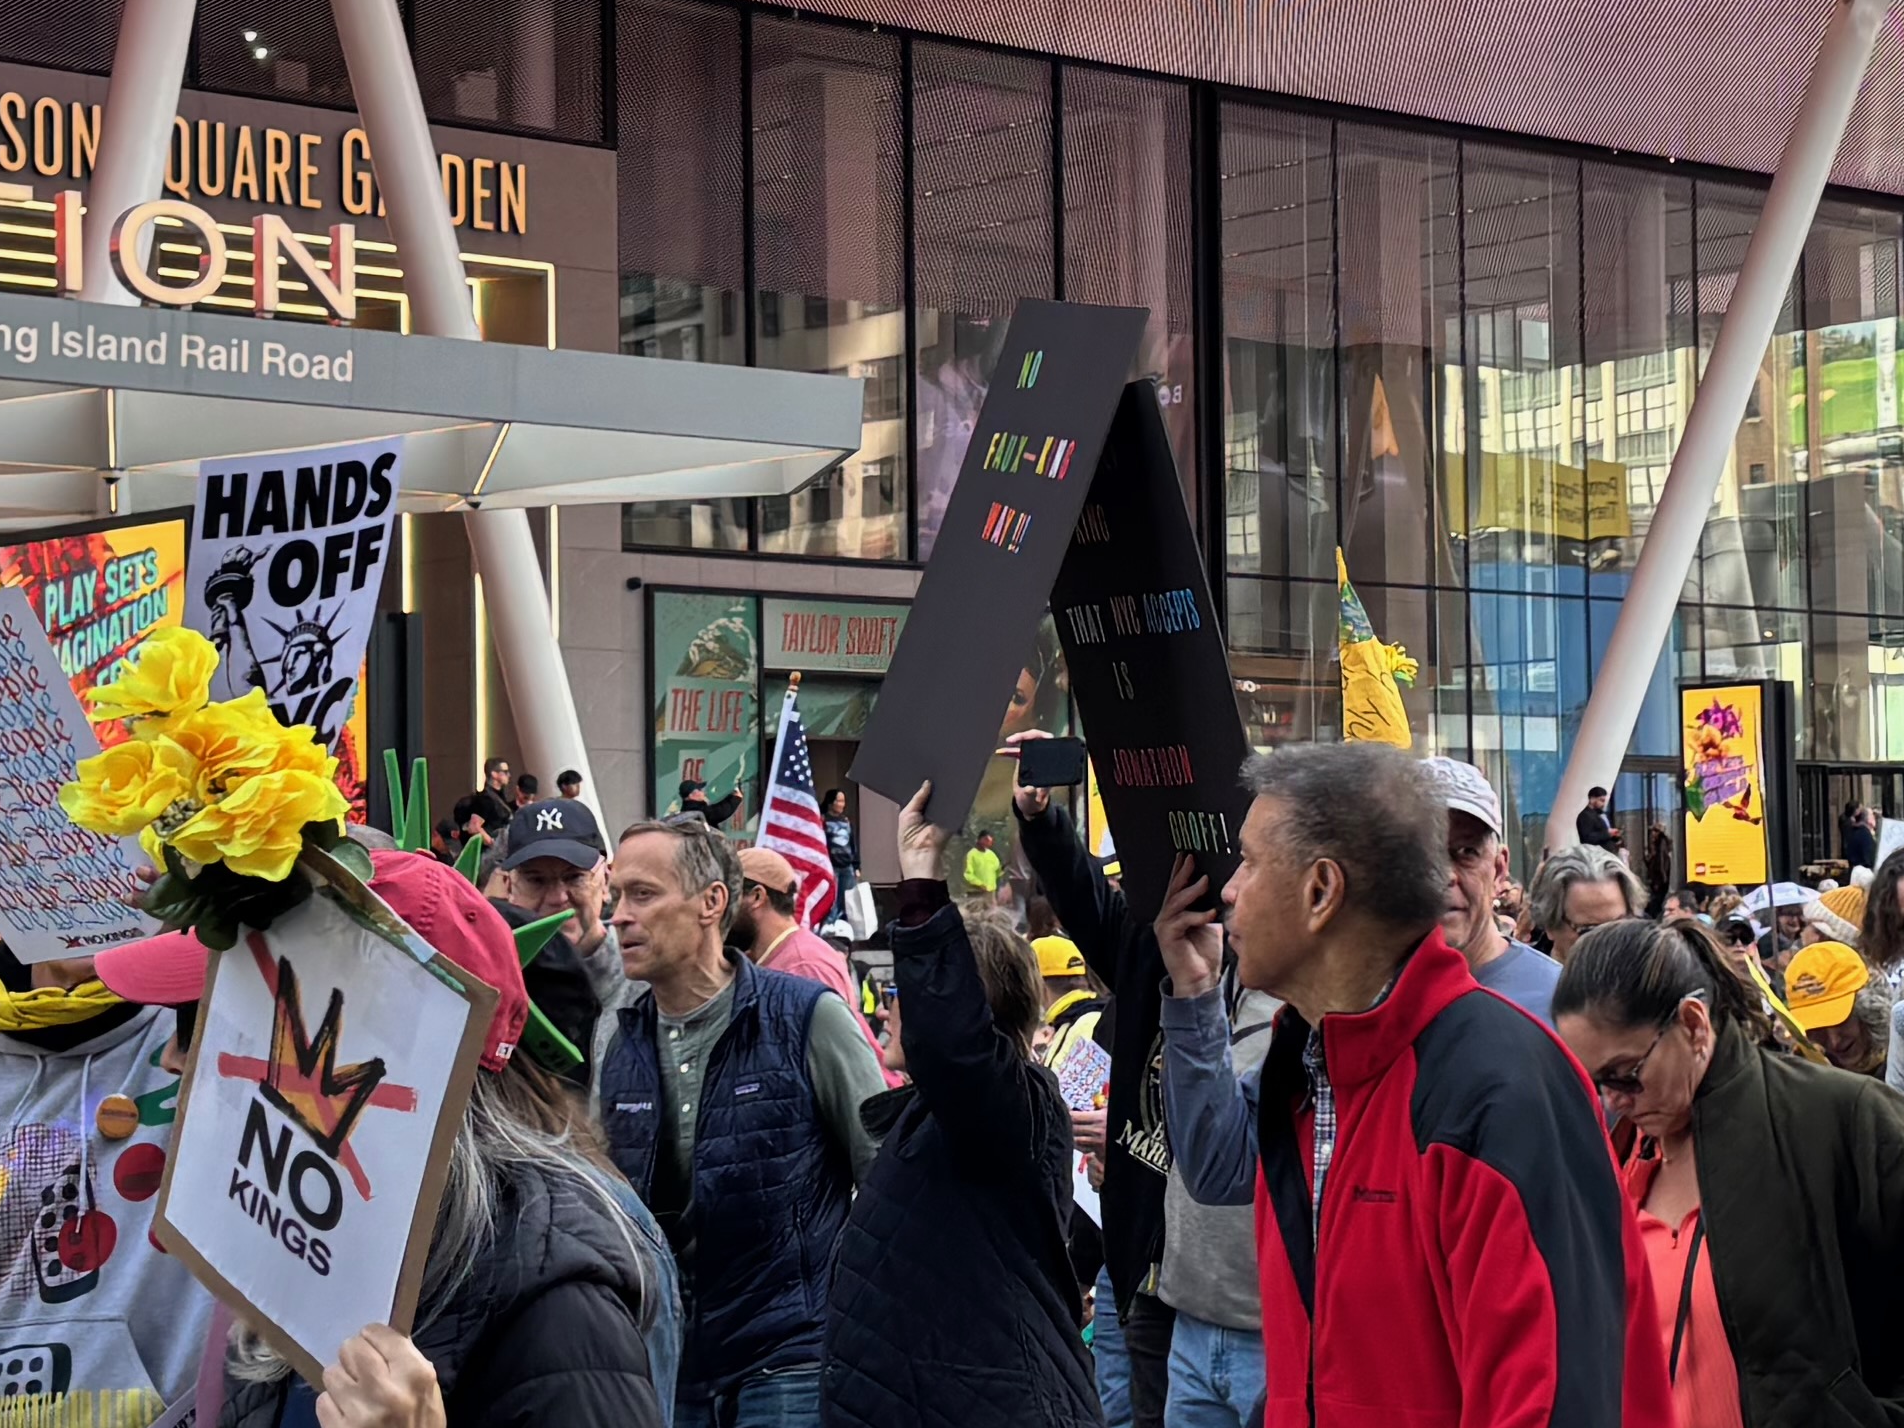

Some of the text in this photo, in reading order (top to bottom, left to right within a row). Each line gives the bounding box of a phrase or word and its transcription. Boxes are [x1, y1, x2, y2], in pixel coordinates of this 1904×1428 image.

[156, 113, 319, 209] QUARE
[338, 130, 528, 235] GDEN
[51, 320, 167, 366] Island
[180, 333, 249, 373] Rail
[262, 341, 354, 383] Road
[1016, 350, 1043, 389] NO
[201, 452, 397, 540] HANDS
[44, 547, 159, 634] PLAY SETS
[268, 523, 386, 608] OFF
[53, 584, 169, 680] AGINATION
[781, 612, 898, 658] TAYLOR SWIFT
[1065, 587, 1201, 645] THAT NYC ACCEPTS
[670, 687, 745, 734] THE LIFE
[1112, 660, 1134, 701] IS
[237, 1096, 344, 1232] NO
[228, 1166, 333, 1277] KINGS
